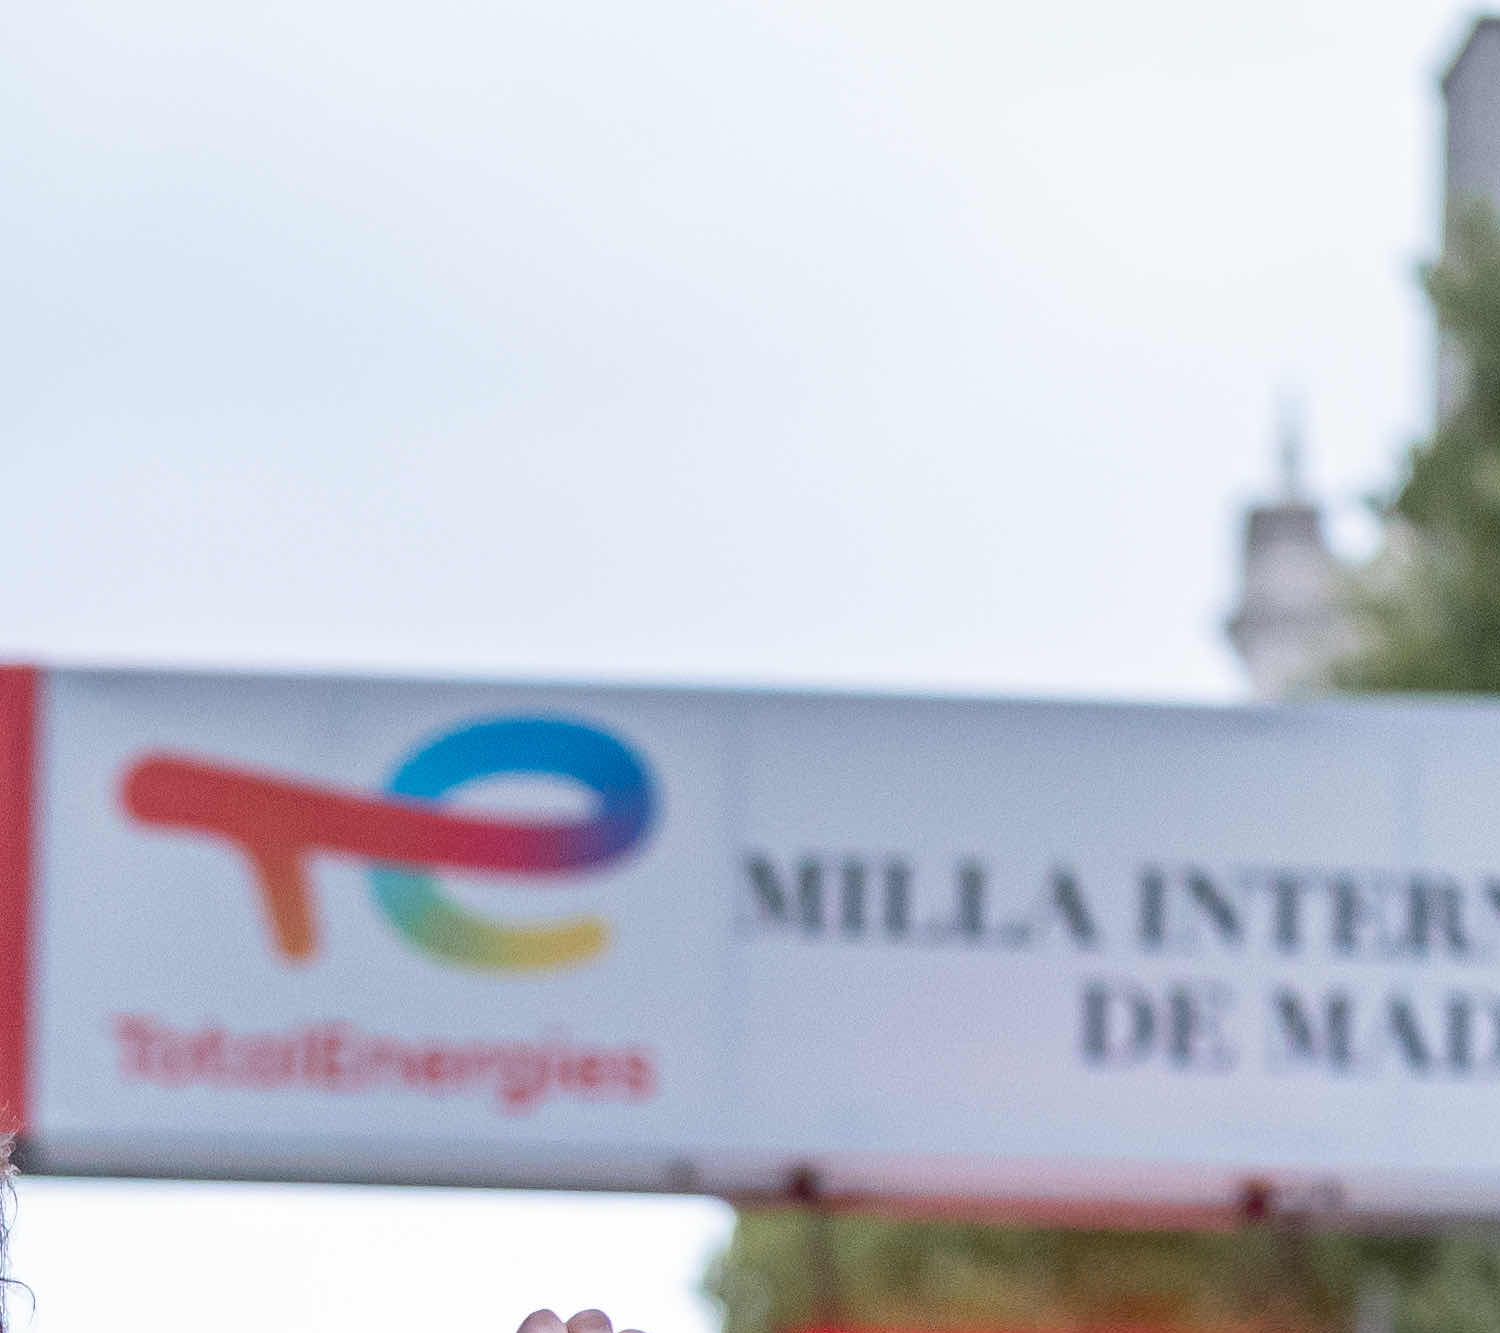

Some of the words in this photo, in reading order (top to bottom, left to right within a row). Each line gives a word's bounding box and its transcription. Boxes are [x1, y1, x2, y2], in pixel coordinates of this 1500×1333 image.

[740, 850, 1102, 952] MILLA
[112, 1010, 660, 1116] TotalEnergies
[1080, 980, 1238, 1076] DE
